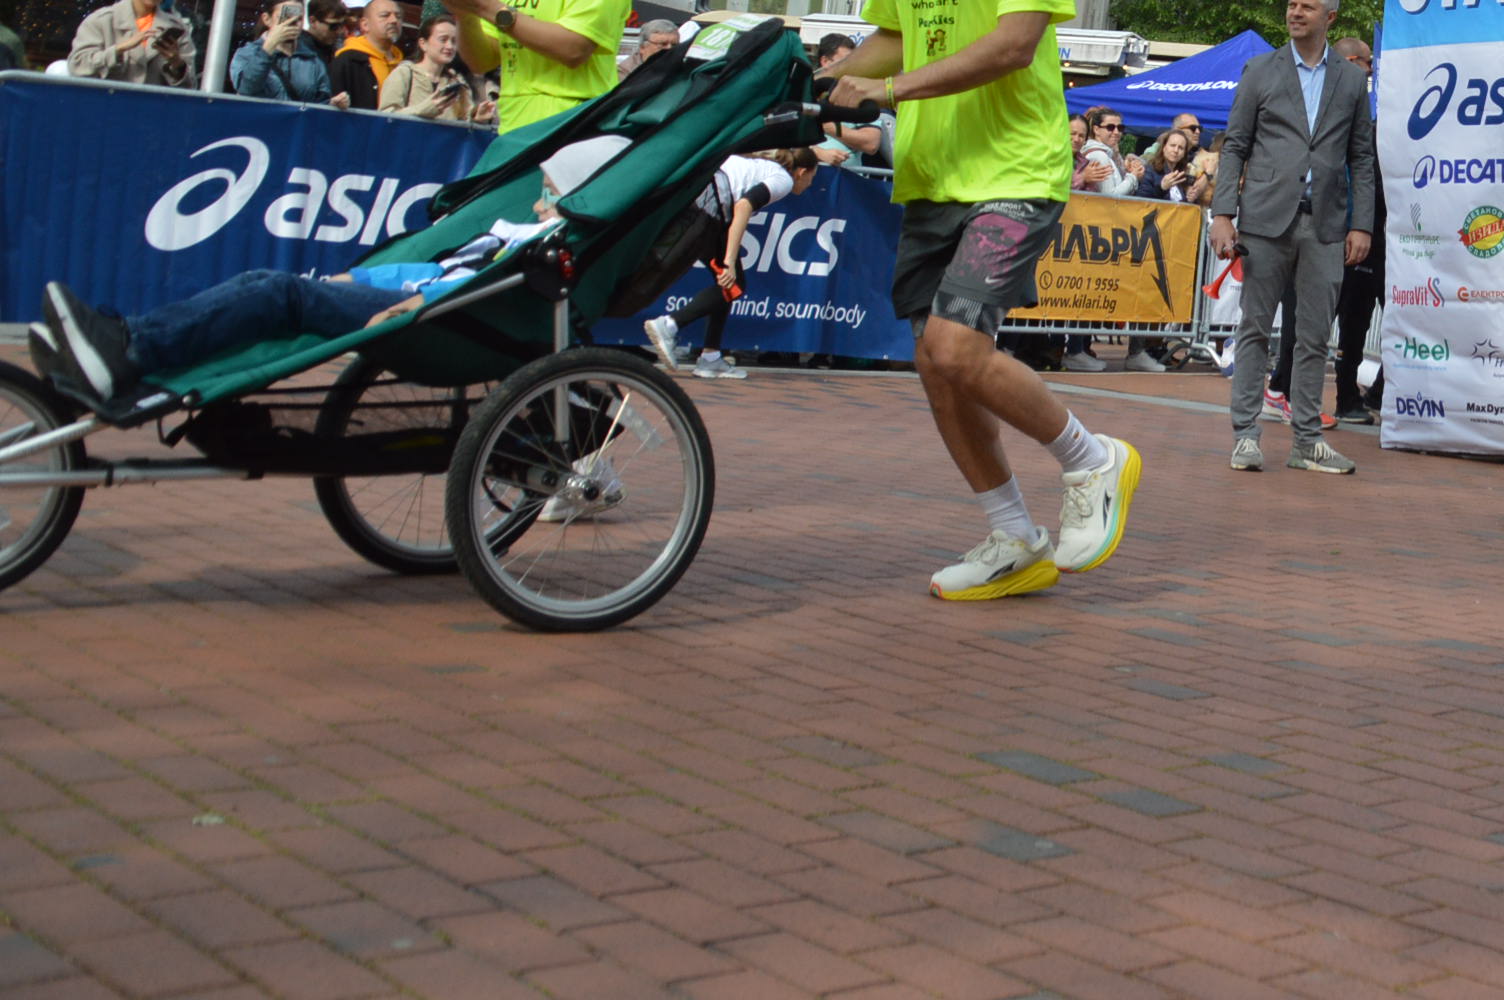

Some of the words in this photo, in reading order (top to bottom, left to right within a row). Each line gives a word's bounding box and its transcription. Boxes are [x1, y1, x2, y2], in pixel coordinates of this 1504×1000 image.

[1149, 80, 1239, 92] DECATHLON
[1056, 275, 1083, 290] 0700
[1086, 276, 1091, 290] 1
[1094, 277, 1120, 291] 9595
[1040, 294, 1117, 314] www.kilari.bg
[1392, 284, 1429, 308] SupraVit
[824, 300, 867, 329] body
[1396, 396, 1445, 418] DEVIN
